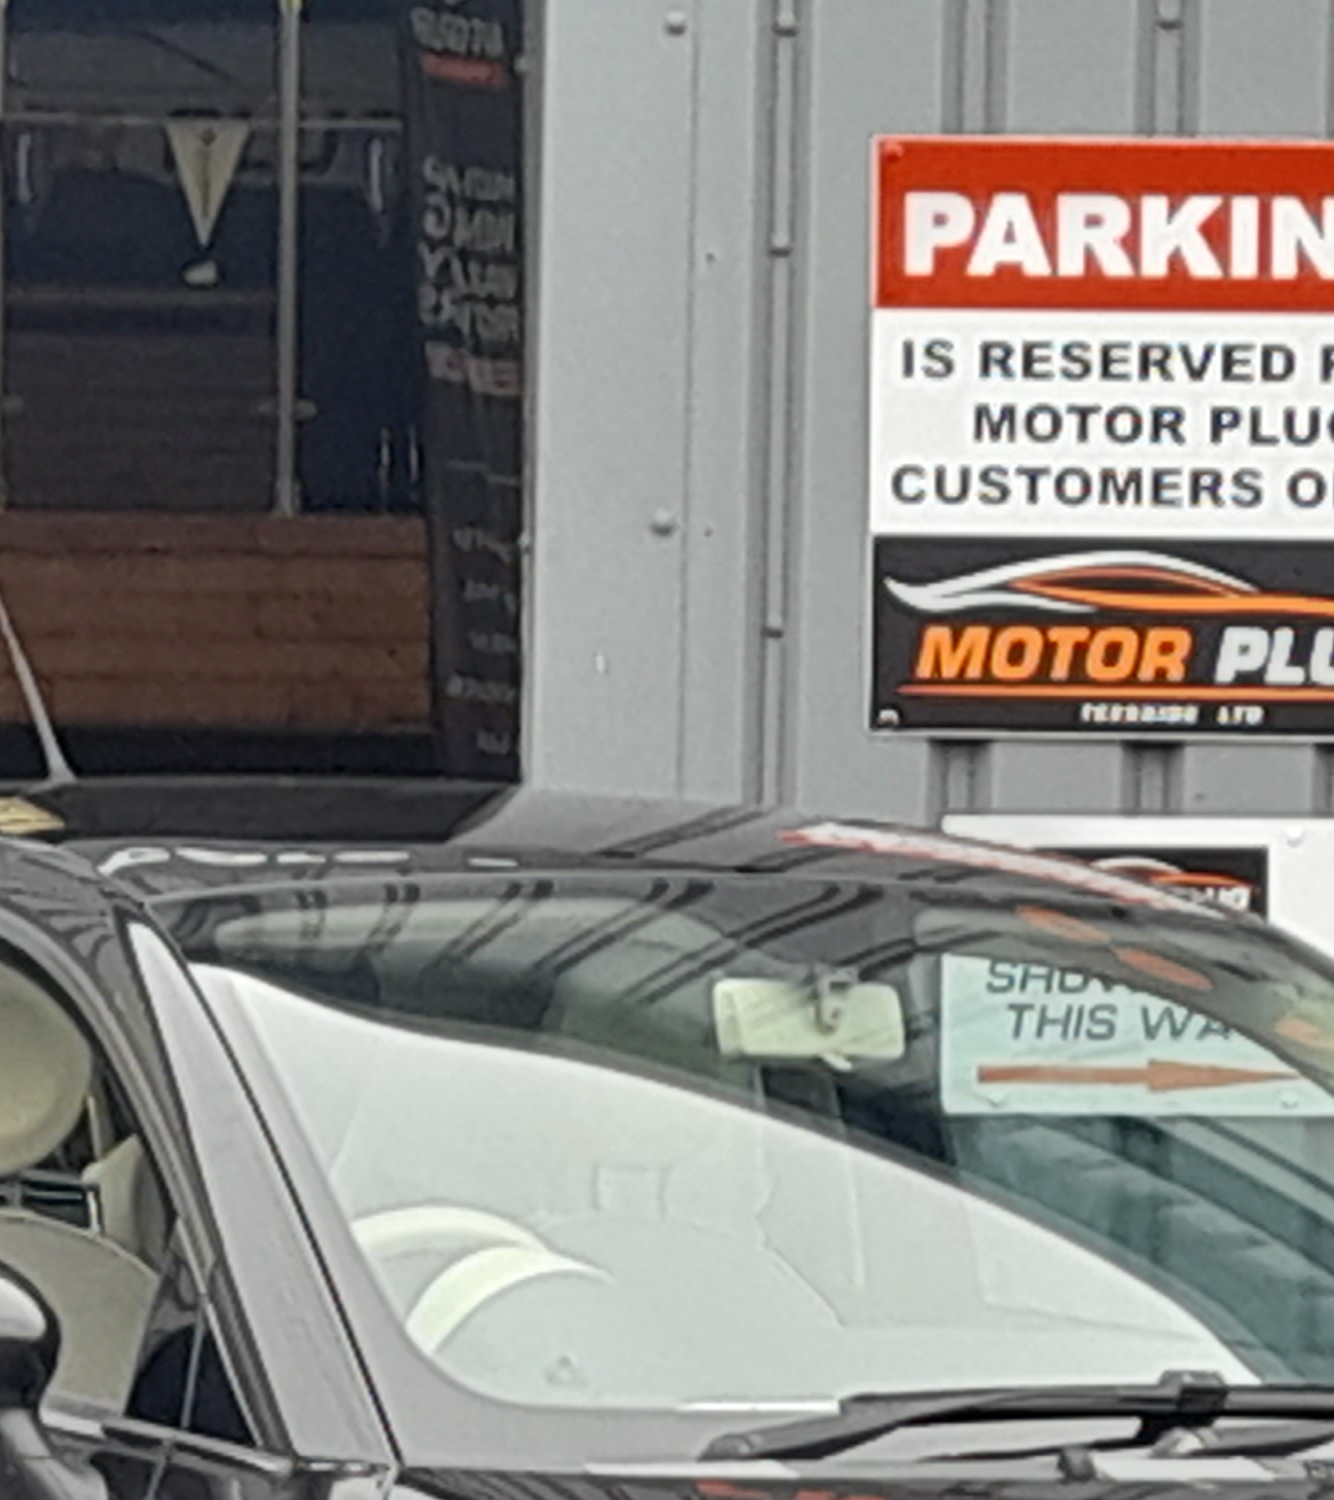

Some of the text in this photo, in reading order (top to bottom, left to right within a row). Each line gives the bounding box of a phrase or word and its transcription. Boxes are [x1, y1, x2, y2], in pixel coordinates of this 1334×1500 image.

[901, 340, 955, 379] IS
[978, 340, 1296, 382] RESERVED
[973, 404, 1187, 445] MOTOR
[891, 465, 1264, 508] CUSTOMERS
[915, 626, 1193, 681] MOTOR
[1008, 1003, 1117, 1041] THIS
